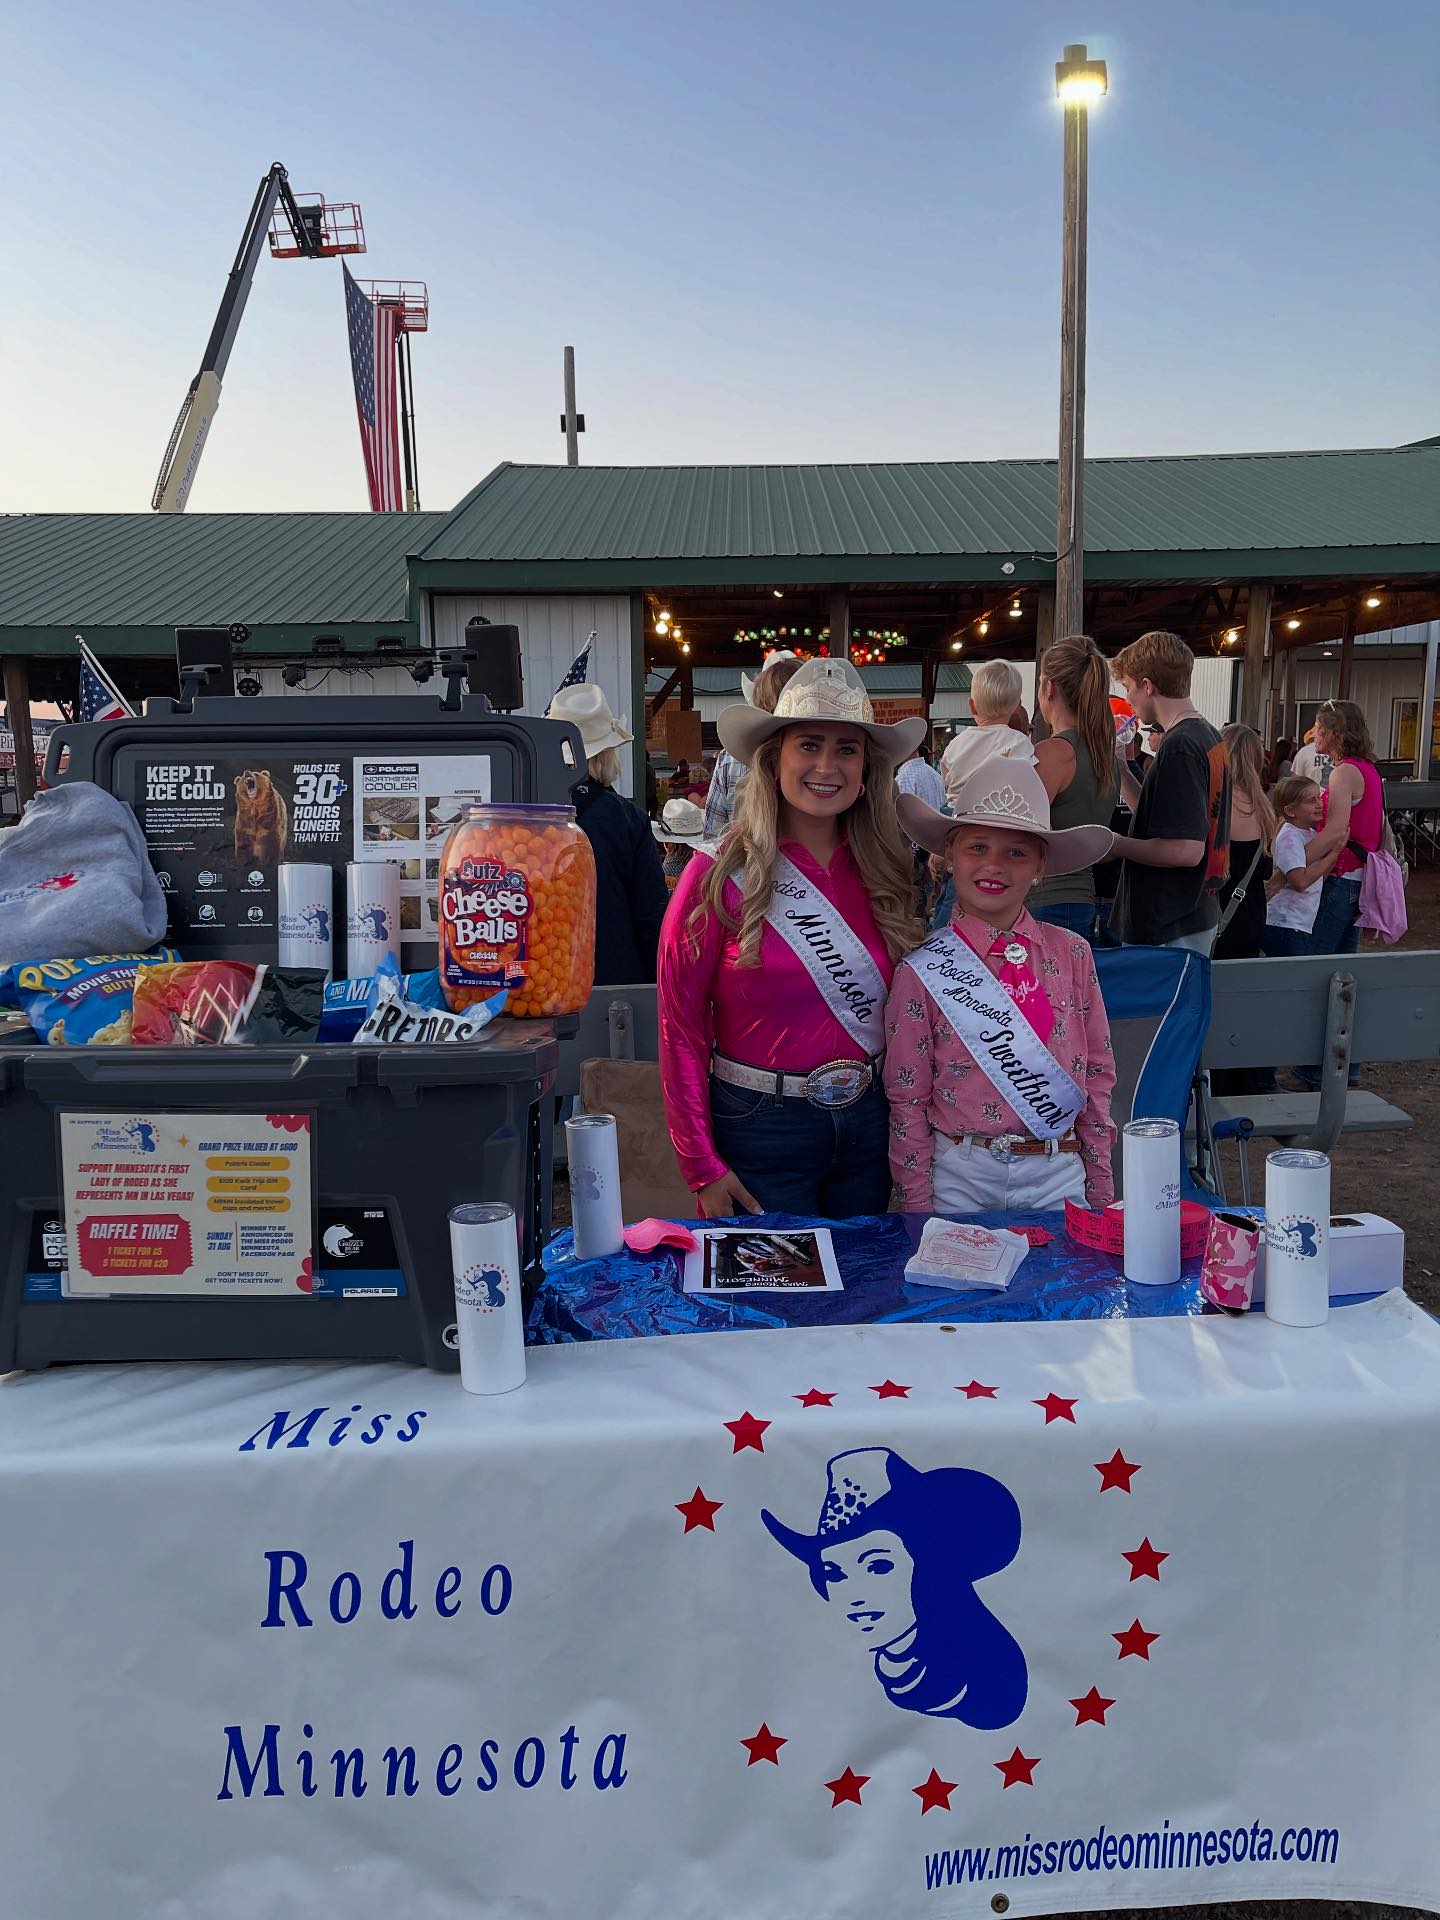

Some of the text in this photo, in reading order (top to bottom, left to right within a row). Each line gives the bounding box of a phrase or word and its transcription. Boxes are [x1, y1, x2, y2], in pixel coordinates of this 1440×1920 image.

[146, 766, 214, 783] KEEP IT
[293, 764, 341, 774] HOLDS ICE
[146, 784, 226, 800] ICE COLD
[364, 783, 418, 791] COOLER
[293, 806, 341, 820] HOURS
[293, 820, 341, 832] LONGER
[293, 832, 342, 842] THAN YETI
[442, 887, 529, 921] Cheese
[280, 923, 306, 931] Rodeo
[454, 918, 518, 946] Balls
[785, 909, 879, 1024] Minnesota
[926, 959, 984, 988] Rodeo
[66, 973, 112, 1001] MOVIE
[329, 984, 346, 998] AND
[943, 986, 1015, 1028] Minnesota
[980, 1030, 1074, 1130] Sweetheart
[96, 1128, 121, 1136] Miss
[101, 1135, 129, 1143] Rodeo
[91, 1142, 138, 1150] Minnesota
[198, 1142, 222, 1151] GRAND
[223, 1142, 242, 1151] PRIZE
[243, 1142, 268, 1151] VALUED
[268, 1142, 279, 1151] AT
[78, 1164, 191, 1174] SUPPORT MINNESOTA'S FIRST
[90, 1177, 179, 1188] LADY OF RODEO AS SHE
[75, 1190, 195, 1201] REPRESENTS MN IN LAS VEGAS!
[1087, 1215, 1102, 1225] TICKET
[89, 1223, 179, 1240] RAFFLE TIME!
[206, 1231, 233, 1241] SUNDAY
[113, 1246, 137, 1255] TICKET
[137, 1247, 152, 1256] FOR
[207, 1242, 232, 1251] 31 AUG
[110, 1259, 137, 1268] TICKETS
[138, 1259, 153, 1267] FOR
[238, 1404, 429, 1452] Miss
[260, 1539, 514, 1629] Rodeo
[216, 1723, 629, 1801] Minnesota
[925, 1817, 1340, 1892] www.missrodeominnesota.com
